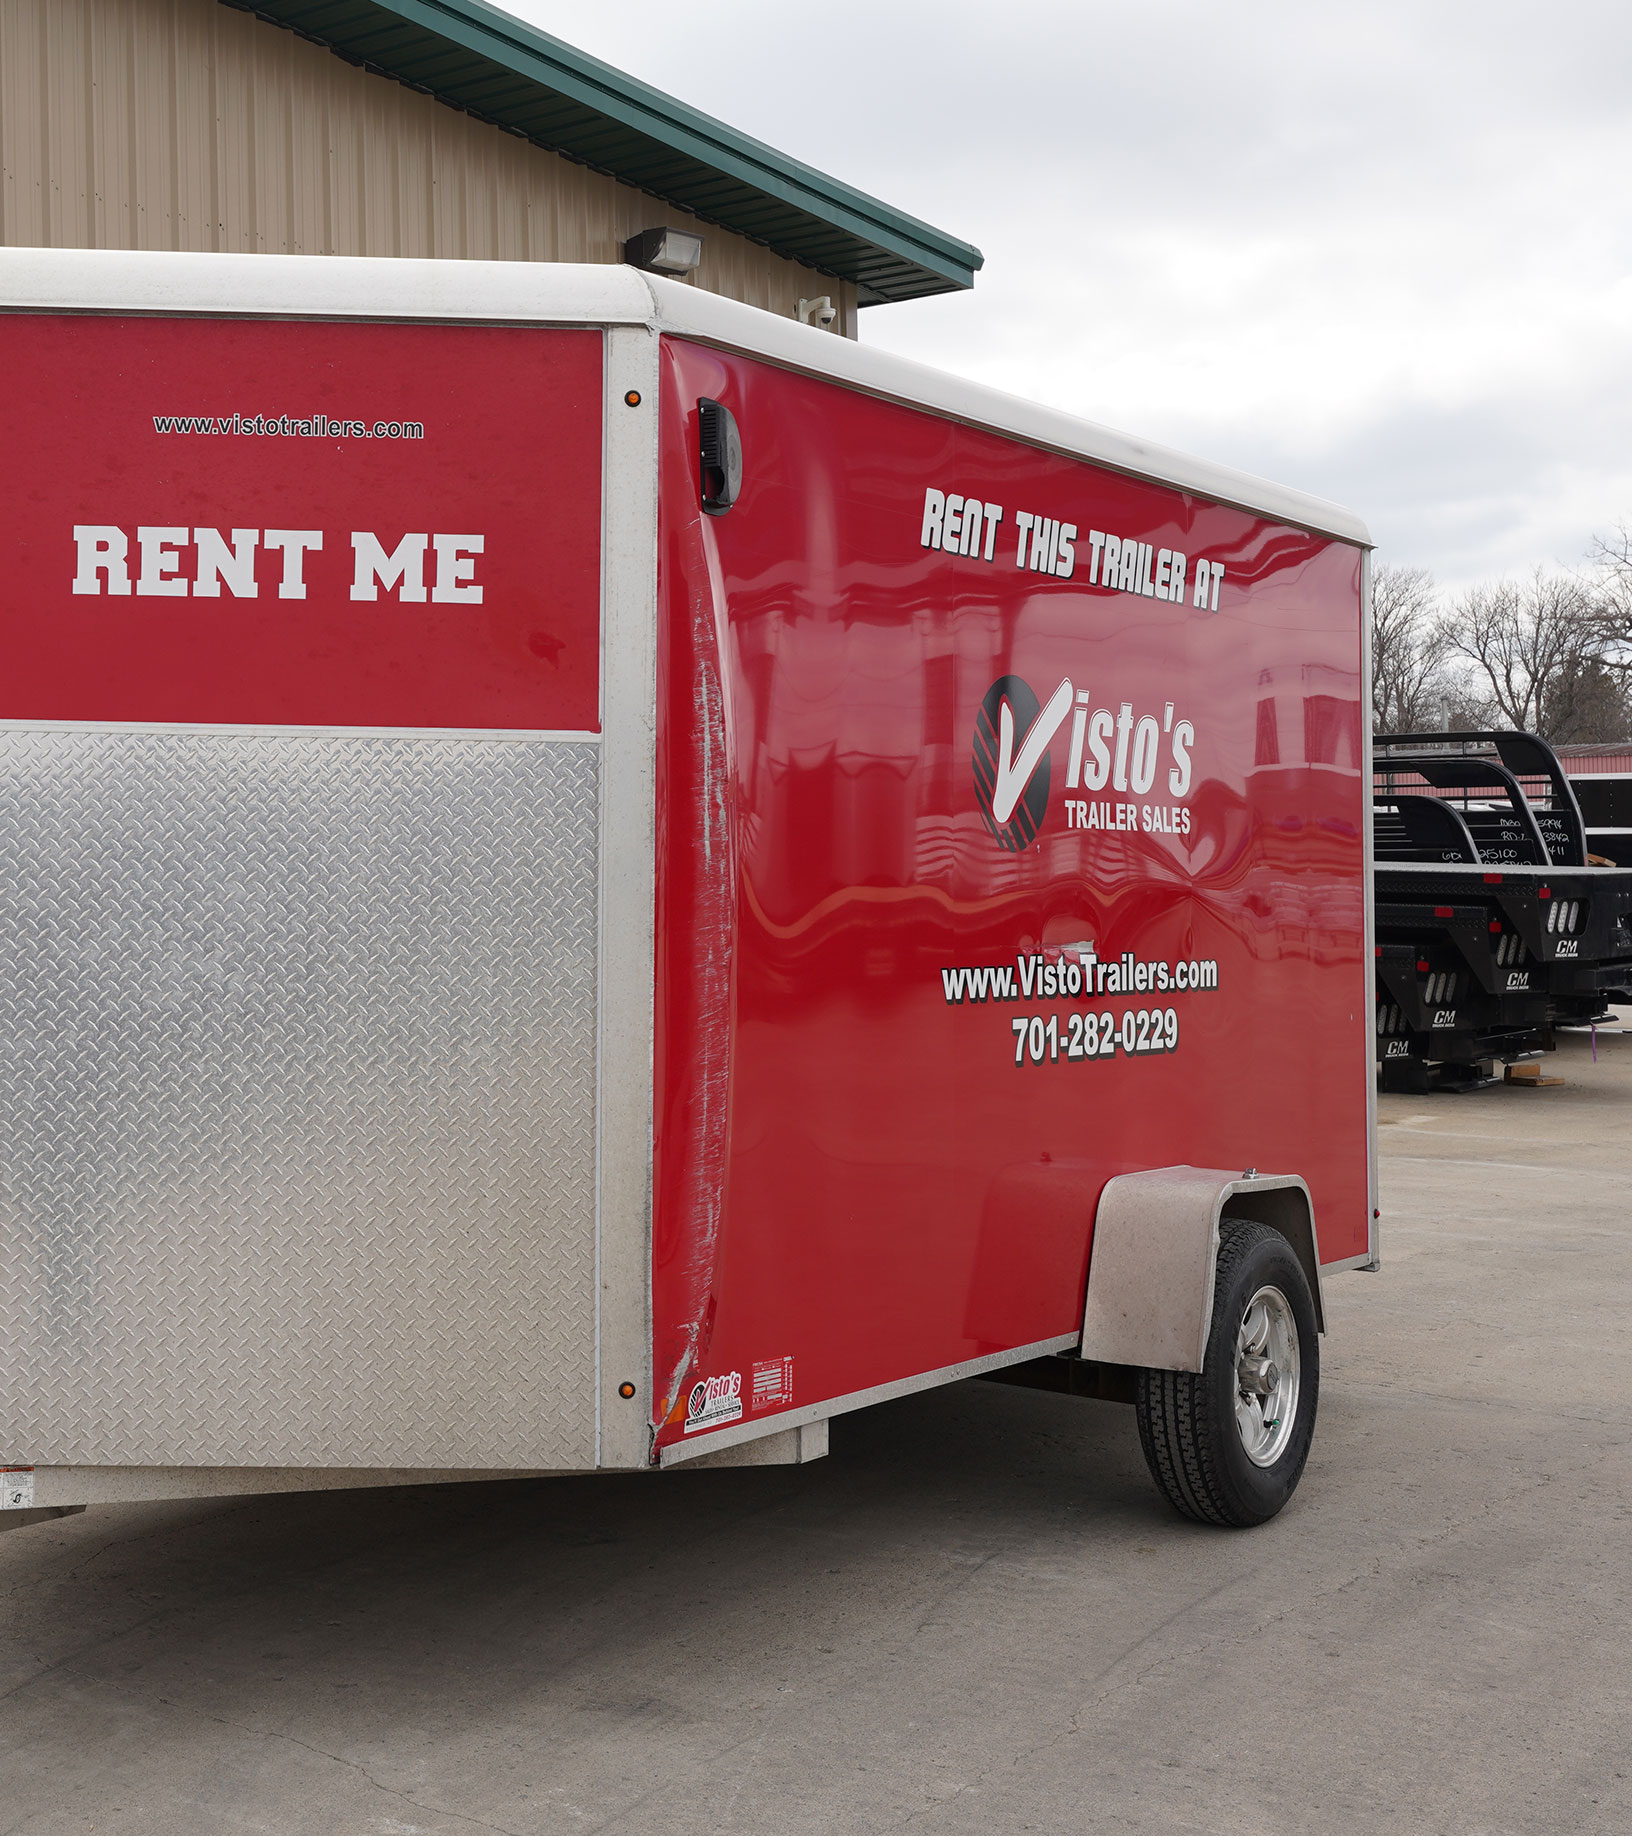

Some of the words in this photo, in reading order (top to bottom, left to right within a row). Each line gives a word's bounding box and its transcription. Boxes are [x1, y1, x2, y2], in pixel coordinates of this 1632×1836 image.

[153, 413, 424, 439] www.vistotrailers.com
[72, 525, 323, 600] RENT
[350, 530, 485, 604] ME
[920, 487, 1003, 563] RENT
[1016, 510, 1077, 580] THIS
[1088, 529, 1187, 605] TRAILER
[1192, 558, 1225, 613] AT
[992, 676, 1195, 824] Visto's
[1065, 799, 1138, 832] TRAILER
[1142, 804, 1191, 834] SALES
[1555, 939, 1579, 954] CM
[941, 951, 1218, 1005] www.VistoTrailers.com
[1506, 971, 1530, 986] CM
[1433, 1009, 1457, 1024] CM
[1012, 1007, 1179, 1067] 701-282-0229
[1387, 1040, 1410, 1054] CM
